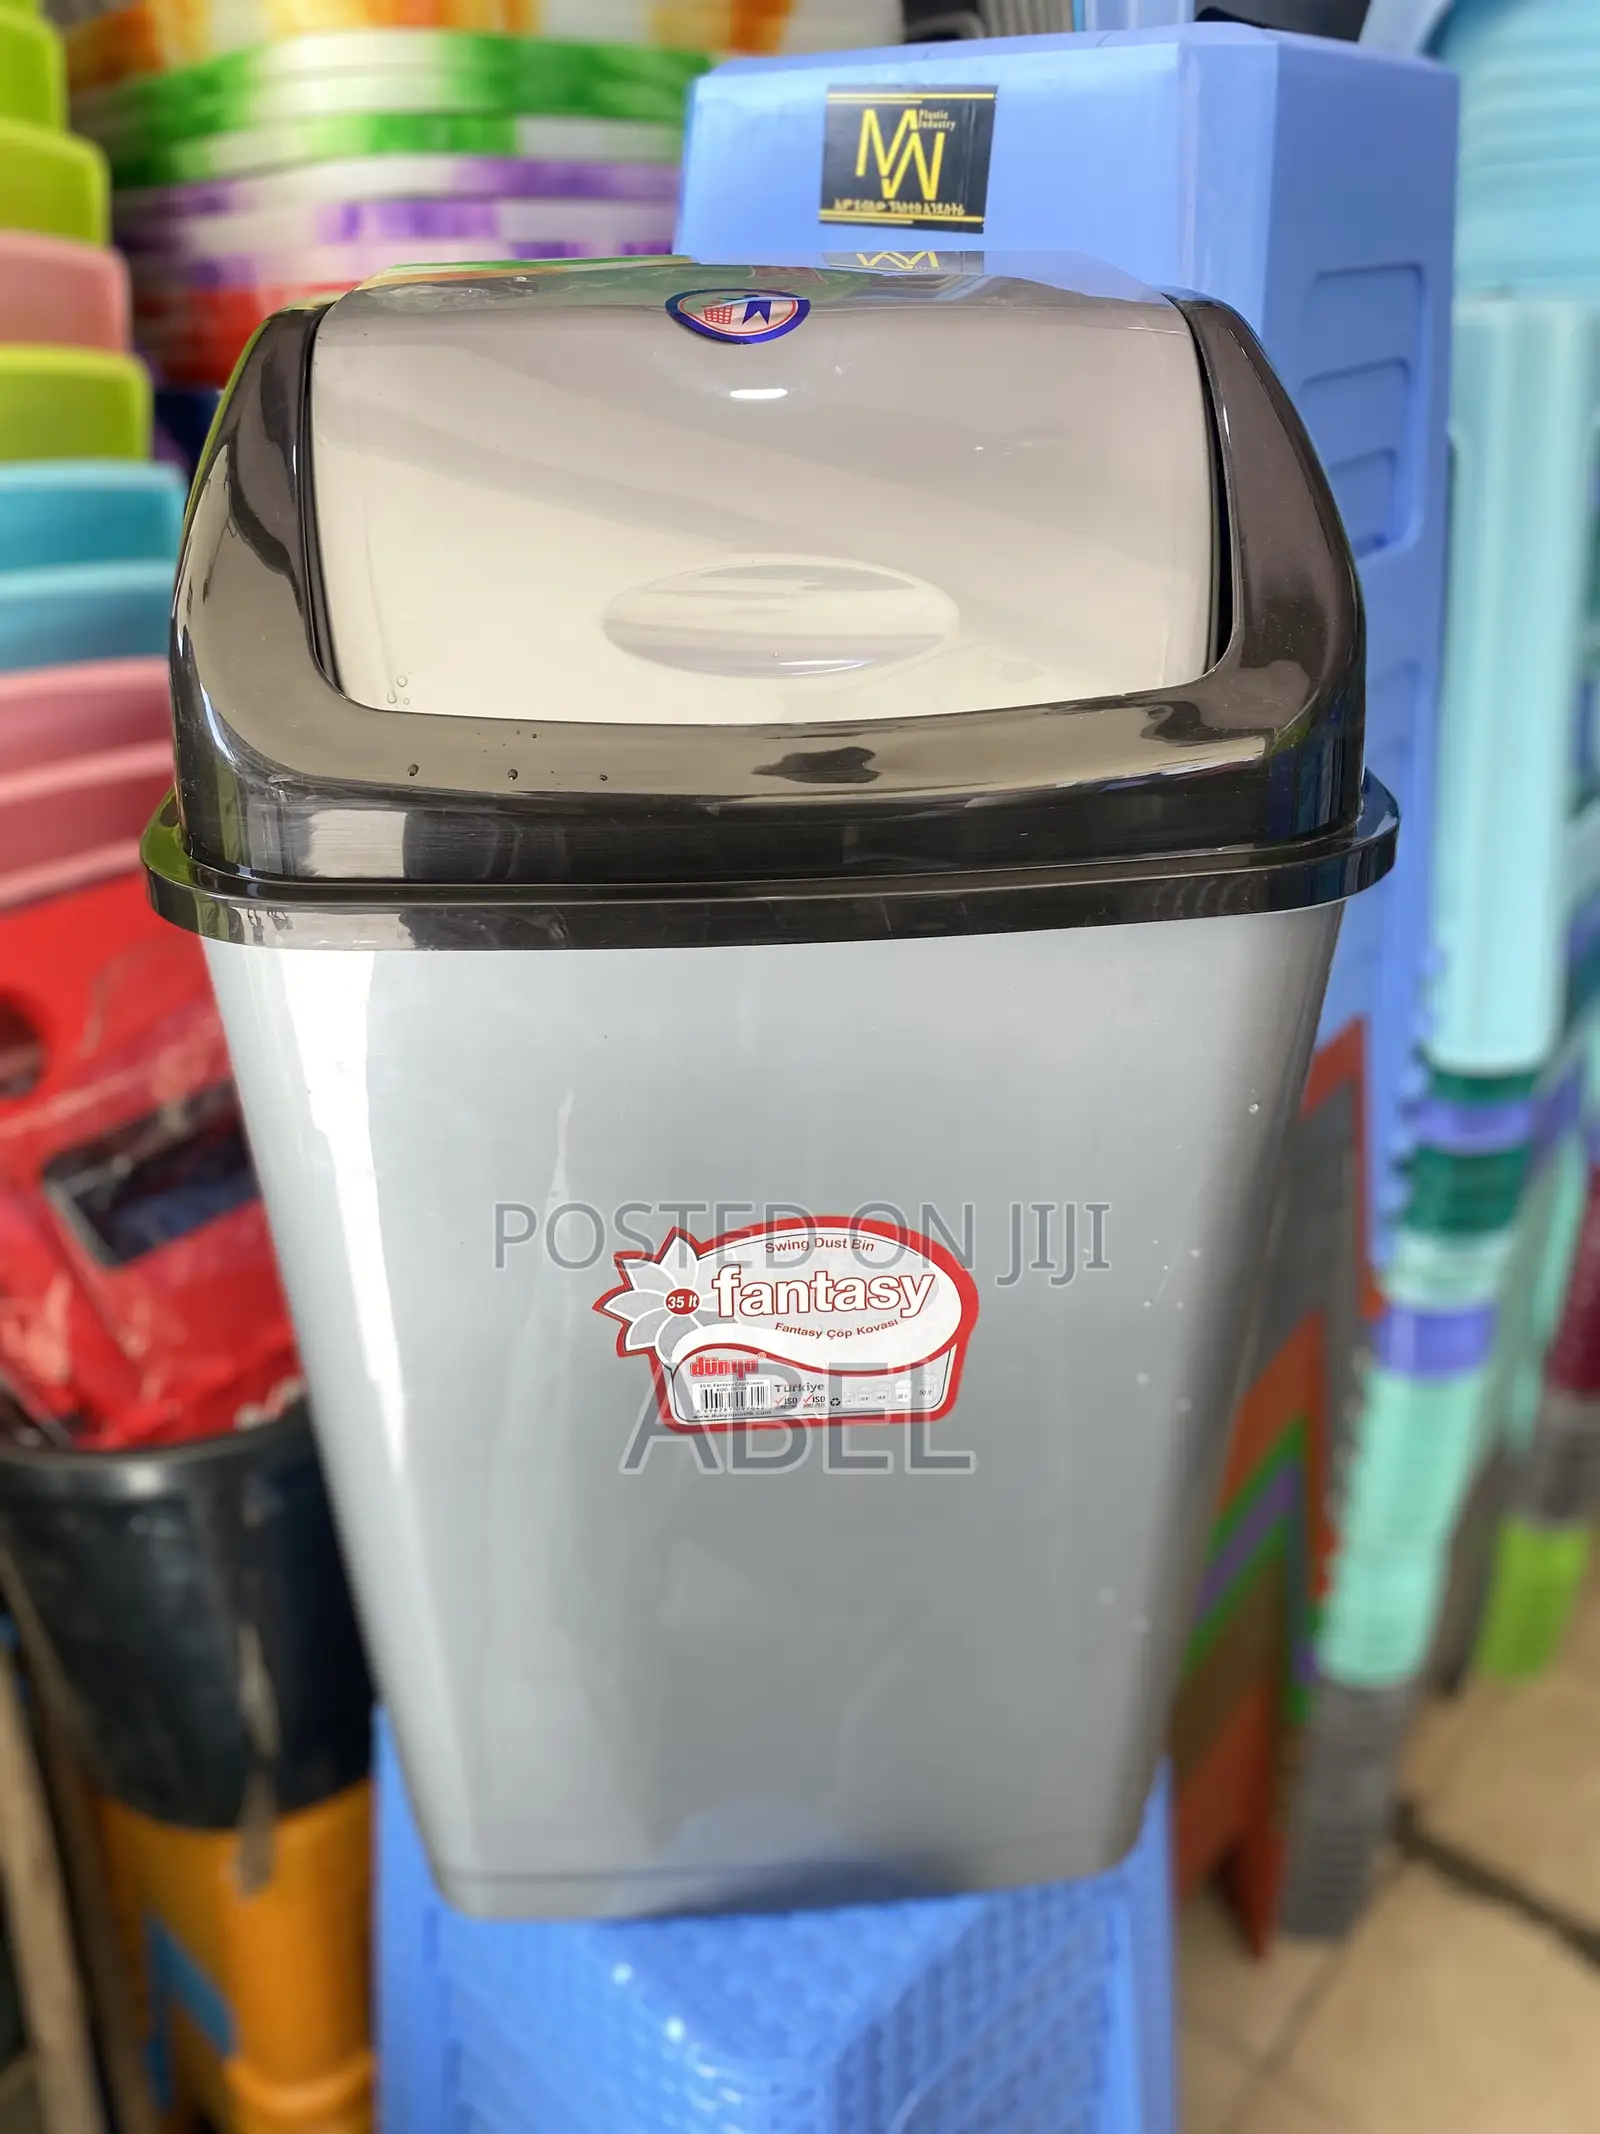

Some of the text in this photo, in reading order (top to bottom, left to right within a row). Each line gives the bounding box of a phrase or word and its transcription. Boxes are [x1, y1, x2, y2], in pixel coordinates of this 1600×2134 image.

[918, 109, 949, 120] Plastic
[918, 120, 956, 132] Industry
[765, 1237, 875, 1254] Swing Dust Bin
[711, 1263, 935, 1318] fantasy
[667, 1295, 699, 1309] 35 lt
[775, 1319, 899, 1340] Fantasy Çöp Kovası
[774, 1382, 825, 1394] Türkiye
[784, 1397, 798, 1405] ISO
[812, 1395, 826, 1403] ISO
